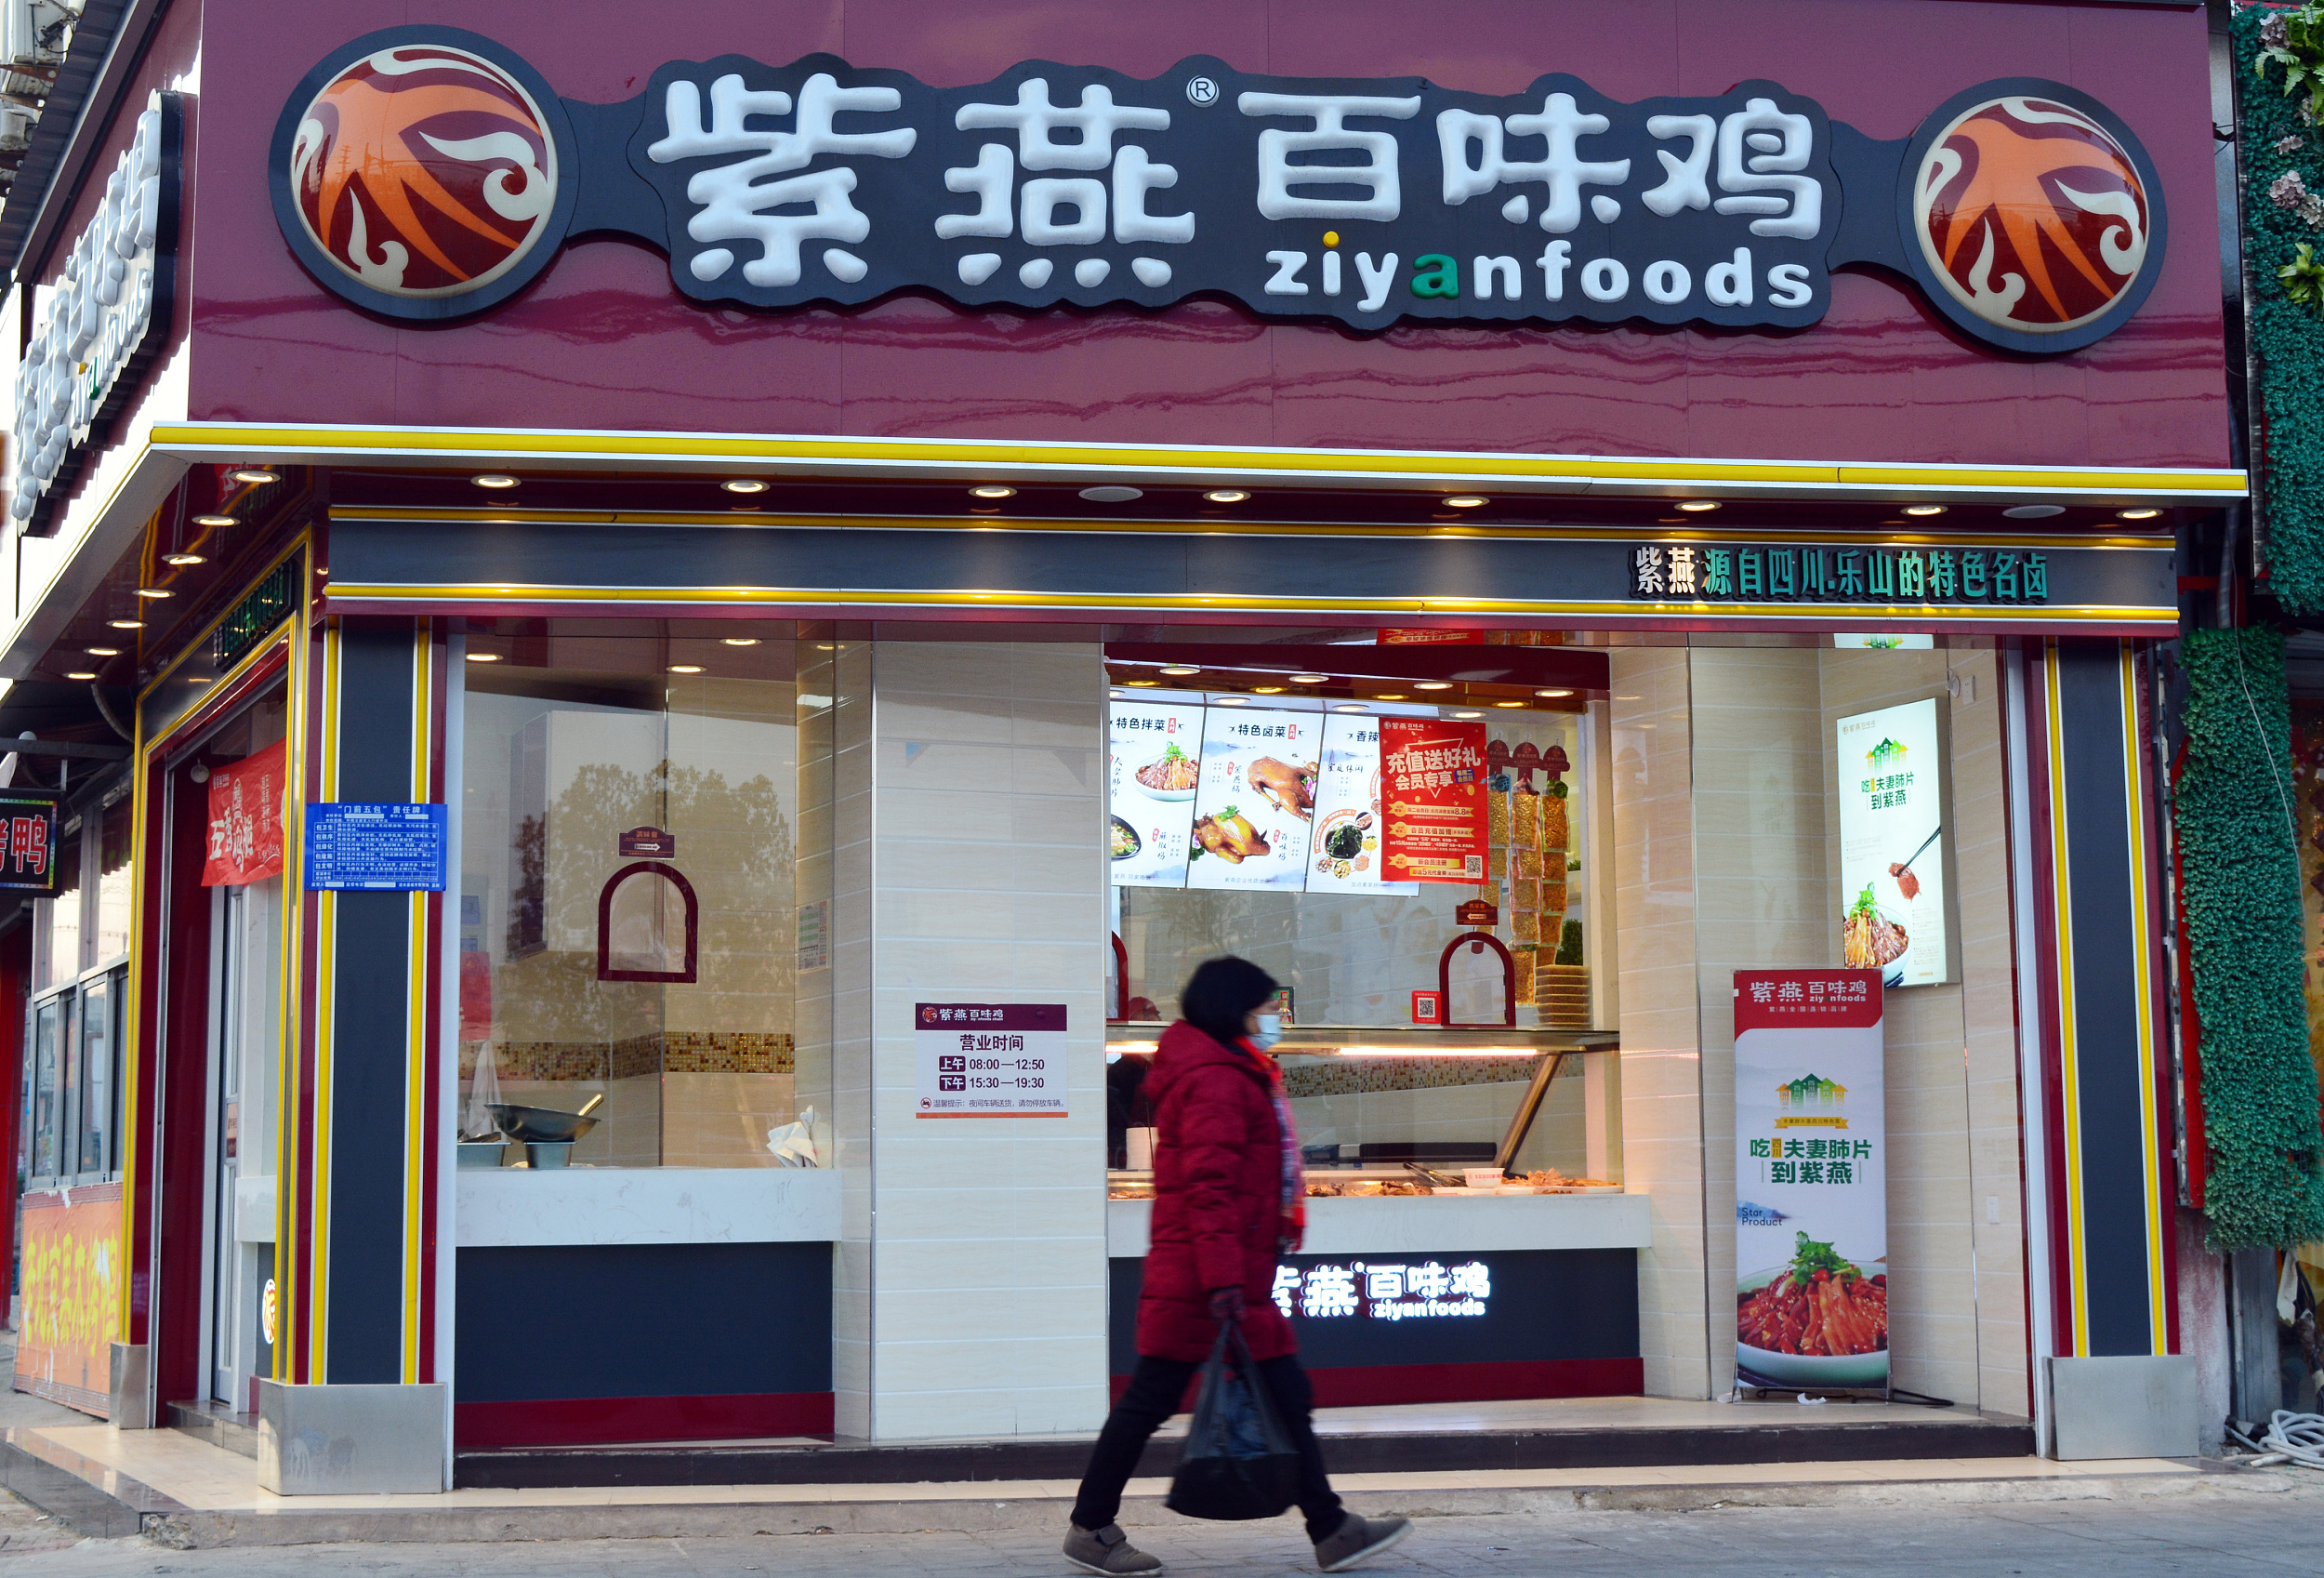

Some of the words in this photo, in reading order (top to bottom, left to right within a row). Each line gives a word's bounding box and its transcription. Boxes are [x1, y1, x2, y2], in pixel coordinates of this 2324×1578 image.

[648, 73, 1195, 288] 紫燕
[1238, 92, 1822, 239] 百味鸡
[1264, 231, 1814, 312] ziyanfoods
[1116, 717, 1166, 731] 特色拌菜
[1238, 723, 1286, 737] 特色卤菜
[1386, 747, 1481, 775] 充值送好礼
[1395, 771, 1453, 790] 会员专享
[1870, 789, 1907, 810] 到紫燕
[1750, 981, 1804, 1003] 紫燕
[1808, 980, 1867, 995] 百味鸡
[939, 1008, 968, 1021] 紫燕
[970, 1008, 1004, 1018] 百味鸡
[960, 1034, 1023, 1052] 营业时间
[941, 1057, 964, 1070] 上午
[941, 1077, 964, 1090] 下午
[1771, 1161, 1852, 1185] 到紫燕
[1741, 1208, 1763, 1217] Star
[1741, 1217, 1782, 1227] Product
[1366, 1262, 1490, 1298] 百味鸡
[1374, 1298, 1486, 1320] ziyanfoods
